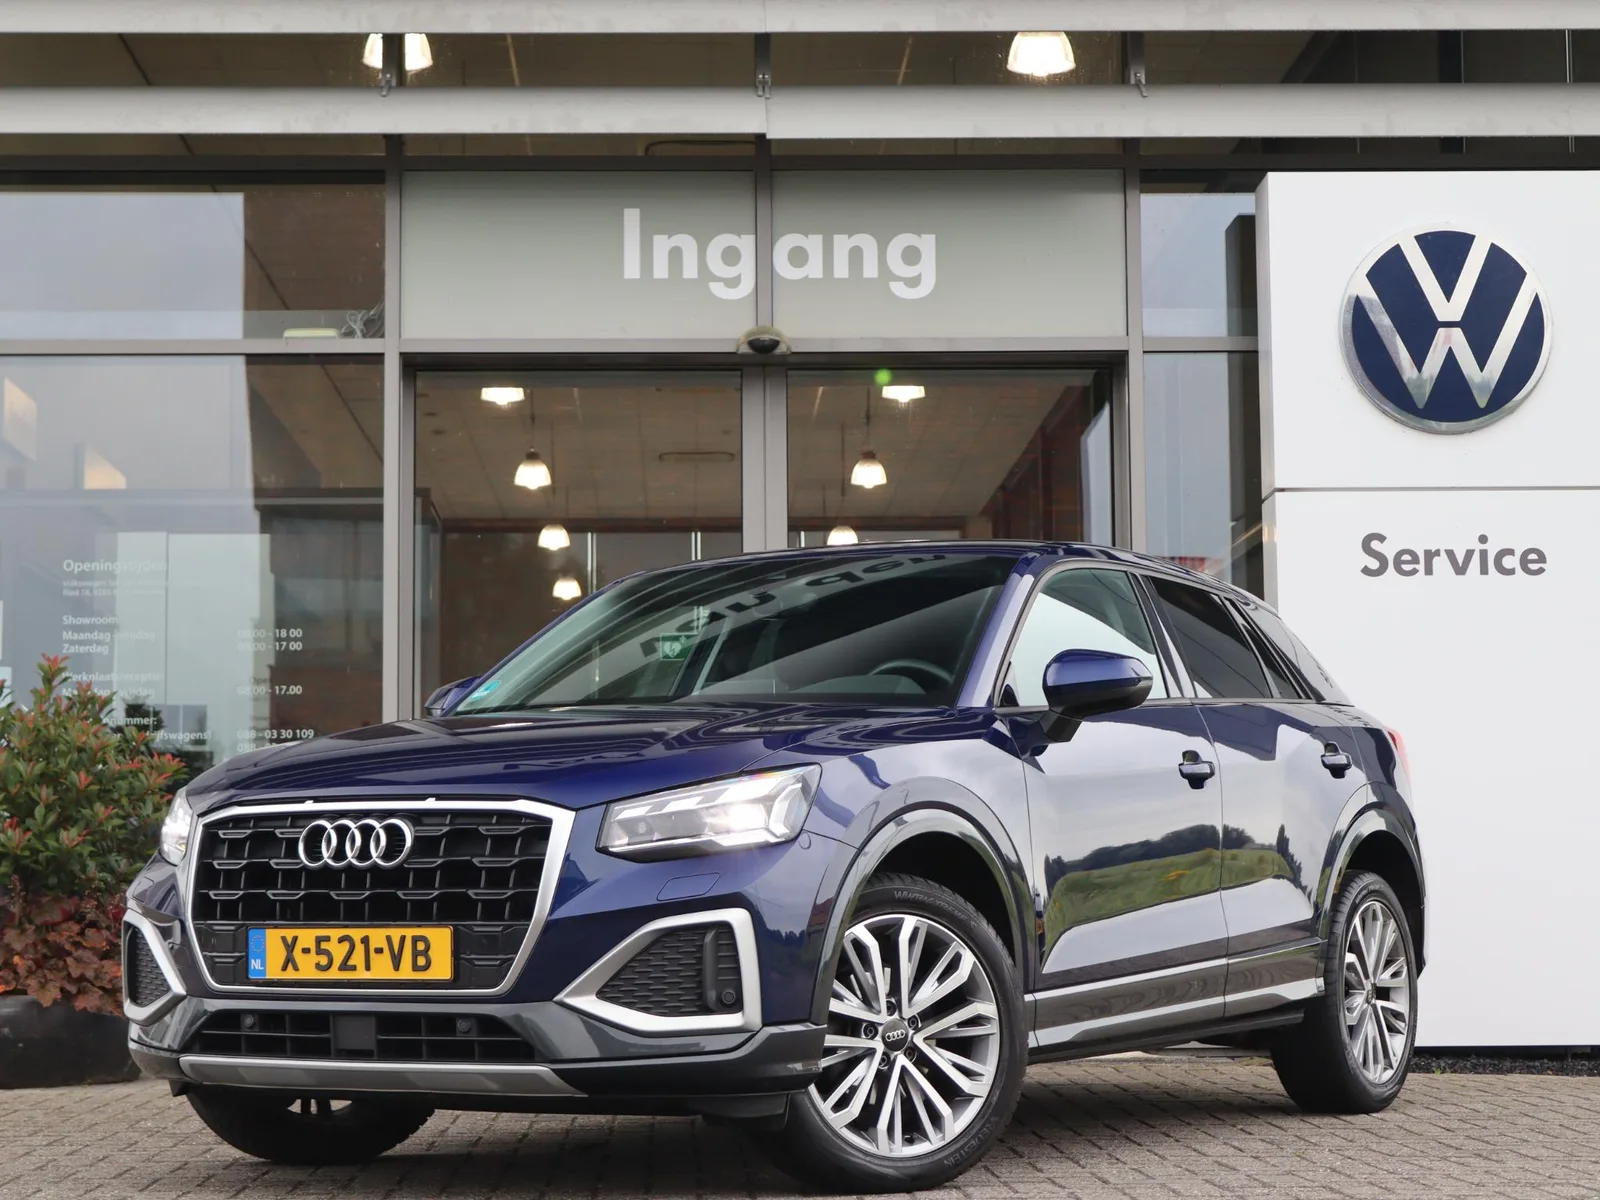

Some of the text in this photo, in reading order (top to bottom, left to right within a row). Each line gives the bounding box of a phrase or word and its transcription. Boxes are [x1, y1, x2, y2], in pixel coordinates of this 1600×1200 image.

[623, 208, 937, 300] Ingang
[1360, 532, 1548, 578] Service
[62, 630, 111, 643] Maandag
[62, 643, 109, 656] Zaterdag
[275, 685, 303, 695] 17.00
[265, 729, 278, 739] 03
[280, 729, 293, 739] 30
[295, 729, 315, 739] 109
[280, 934, 432, 972] X-521-VB
[251, 958, 264, 970] NL
